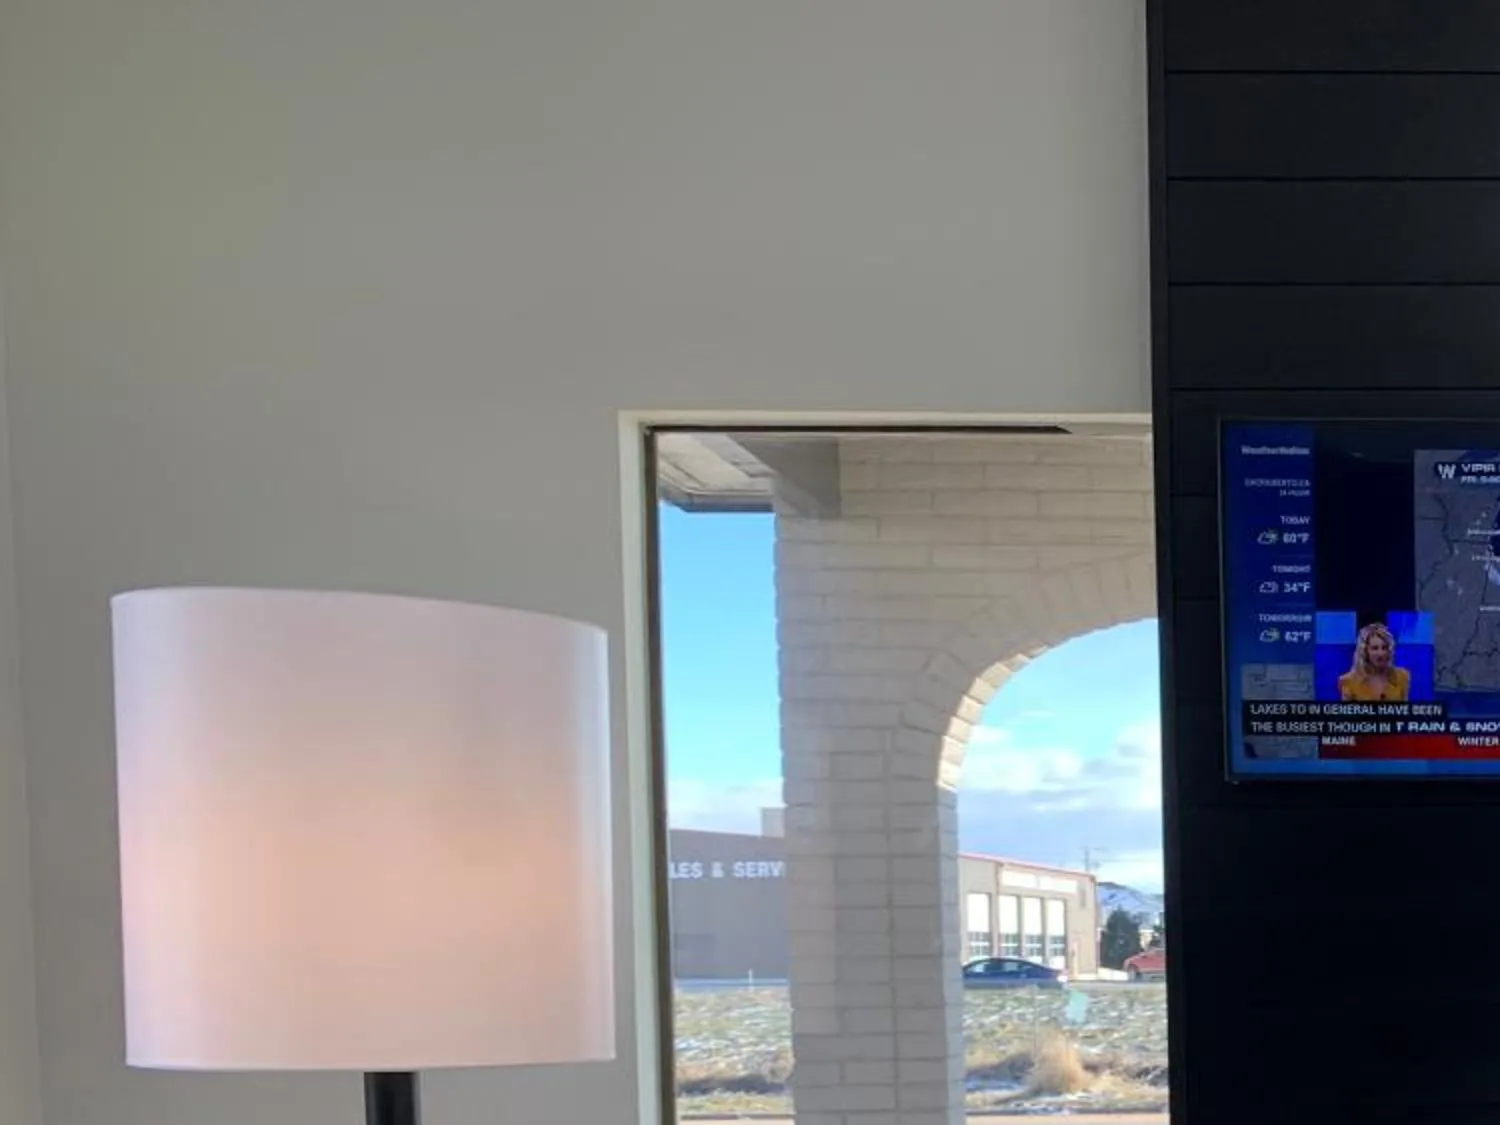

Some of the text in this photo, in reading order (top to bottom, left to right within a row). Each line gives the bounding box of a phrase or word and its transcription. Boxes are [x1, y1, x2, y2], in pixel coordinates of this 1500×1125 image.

[1279, 515, 1311, 525] TODAY
[1250, 703, 1288, 715] LAKES
[1290, 703, 1307, 715] TO
[1323, 703, 1377, 715] GENERAL
[1378, 703, 1410, 715] HAVE
[1411, 703, 1443, 716] BEEN
[1250, 721, 1391, 733] THE BUSIEST THOUGH IN
[1407, 721, 1445, 733] RAIN
[1448, 721, 1461, 733] &
[1321, 735, 1356, 747] MAINE
[1457, 736, 1499, 747] WINTER
[733, 861, 786, 878] SERV
